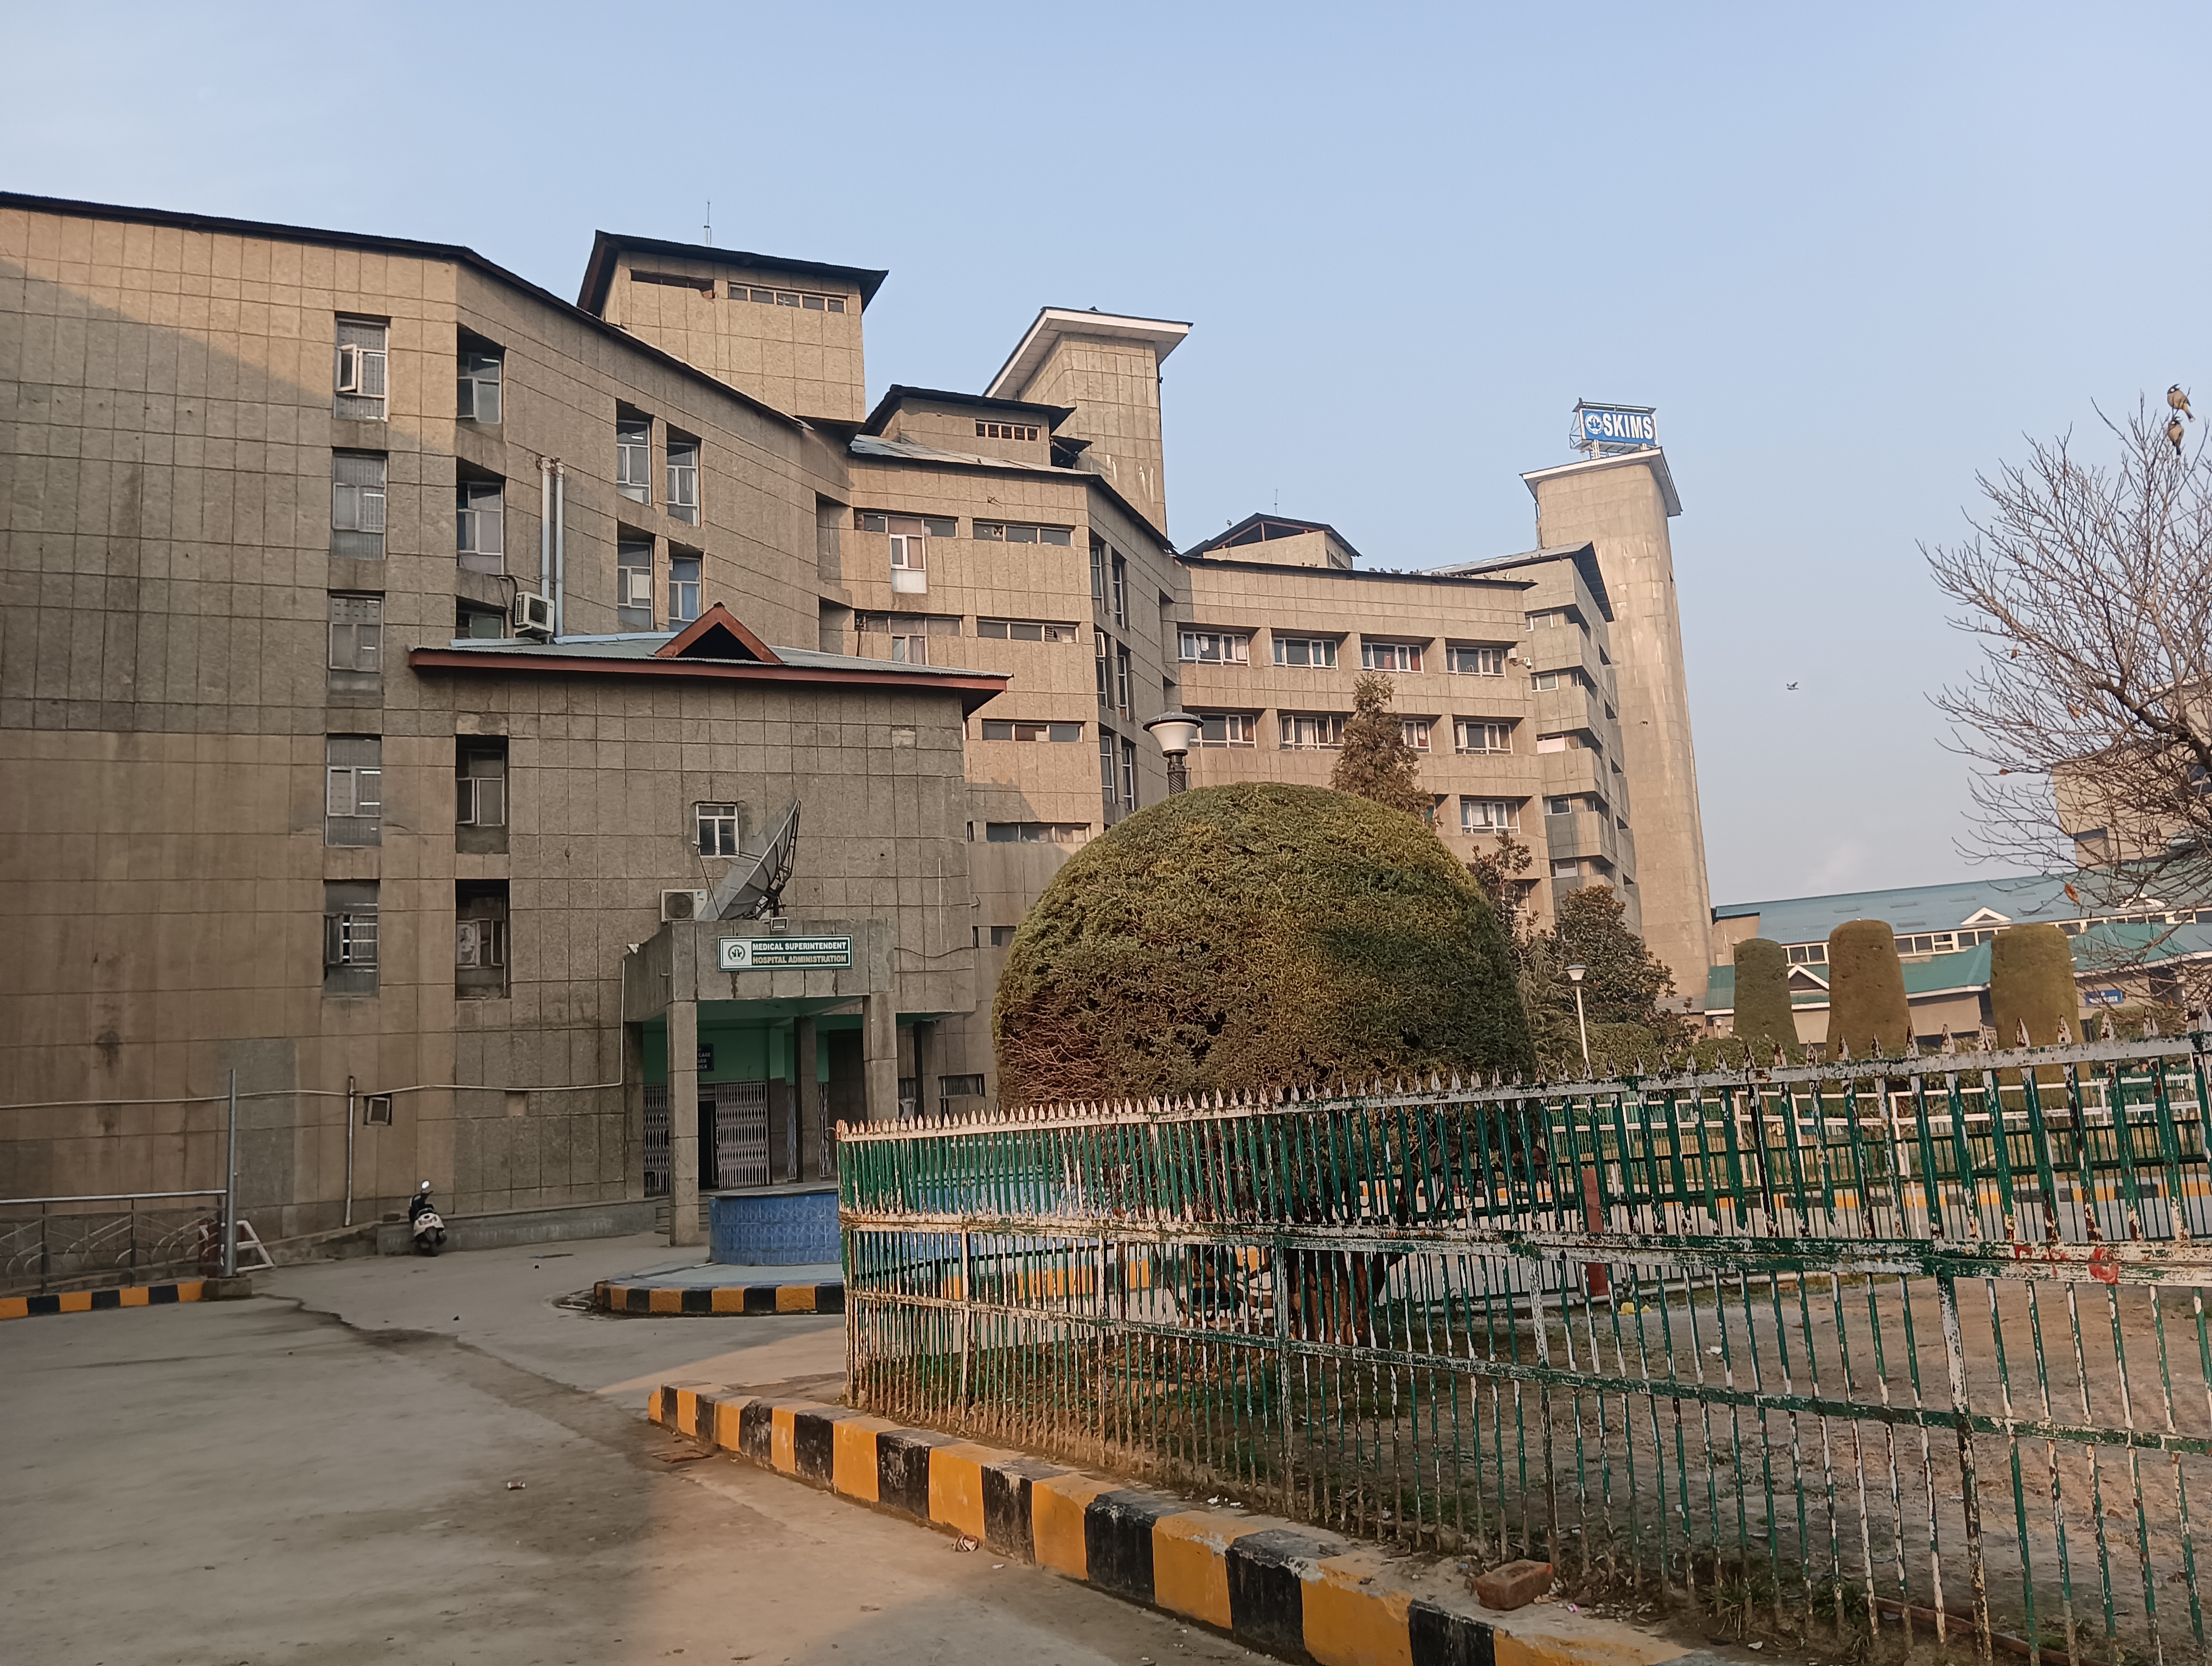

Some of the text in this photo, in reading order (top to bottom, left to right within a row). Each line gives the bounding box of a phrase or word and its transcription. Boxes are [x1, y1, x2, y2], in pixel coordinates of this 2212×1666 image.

[1603, 413, 1654, 440] SKIMS
[753, 941, 847, 951] MEDICAL SUPERINTENDENT
[753, 955, 846, 964] HOSPITAL ADMINISTRATION
